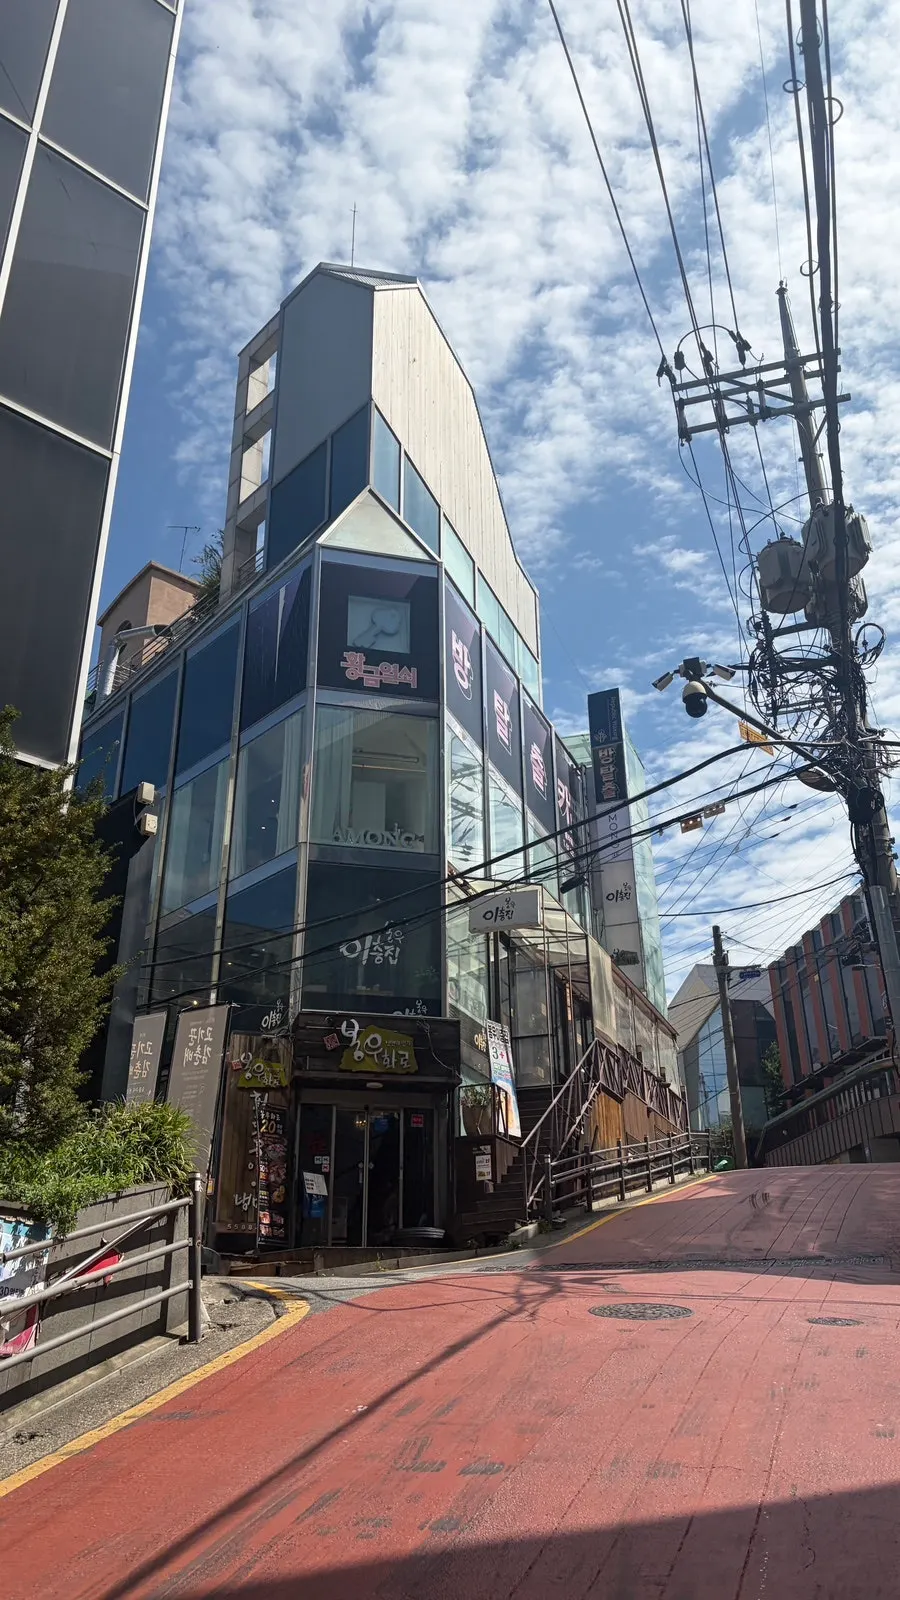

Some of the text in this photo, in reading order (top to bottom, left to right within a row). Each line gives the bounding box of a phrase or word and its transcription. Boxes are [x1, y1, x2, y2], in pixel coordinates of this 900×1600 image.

[340, 651, 418, 689] 황금열쇠
[482, 906, 514, 923] 이층집
[339, 935, 401, 966] 이층집
